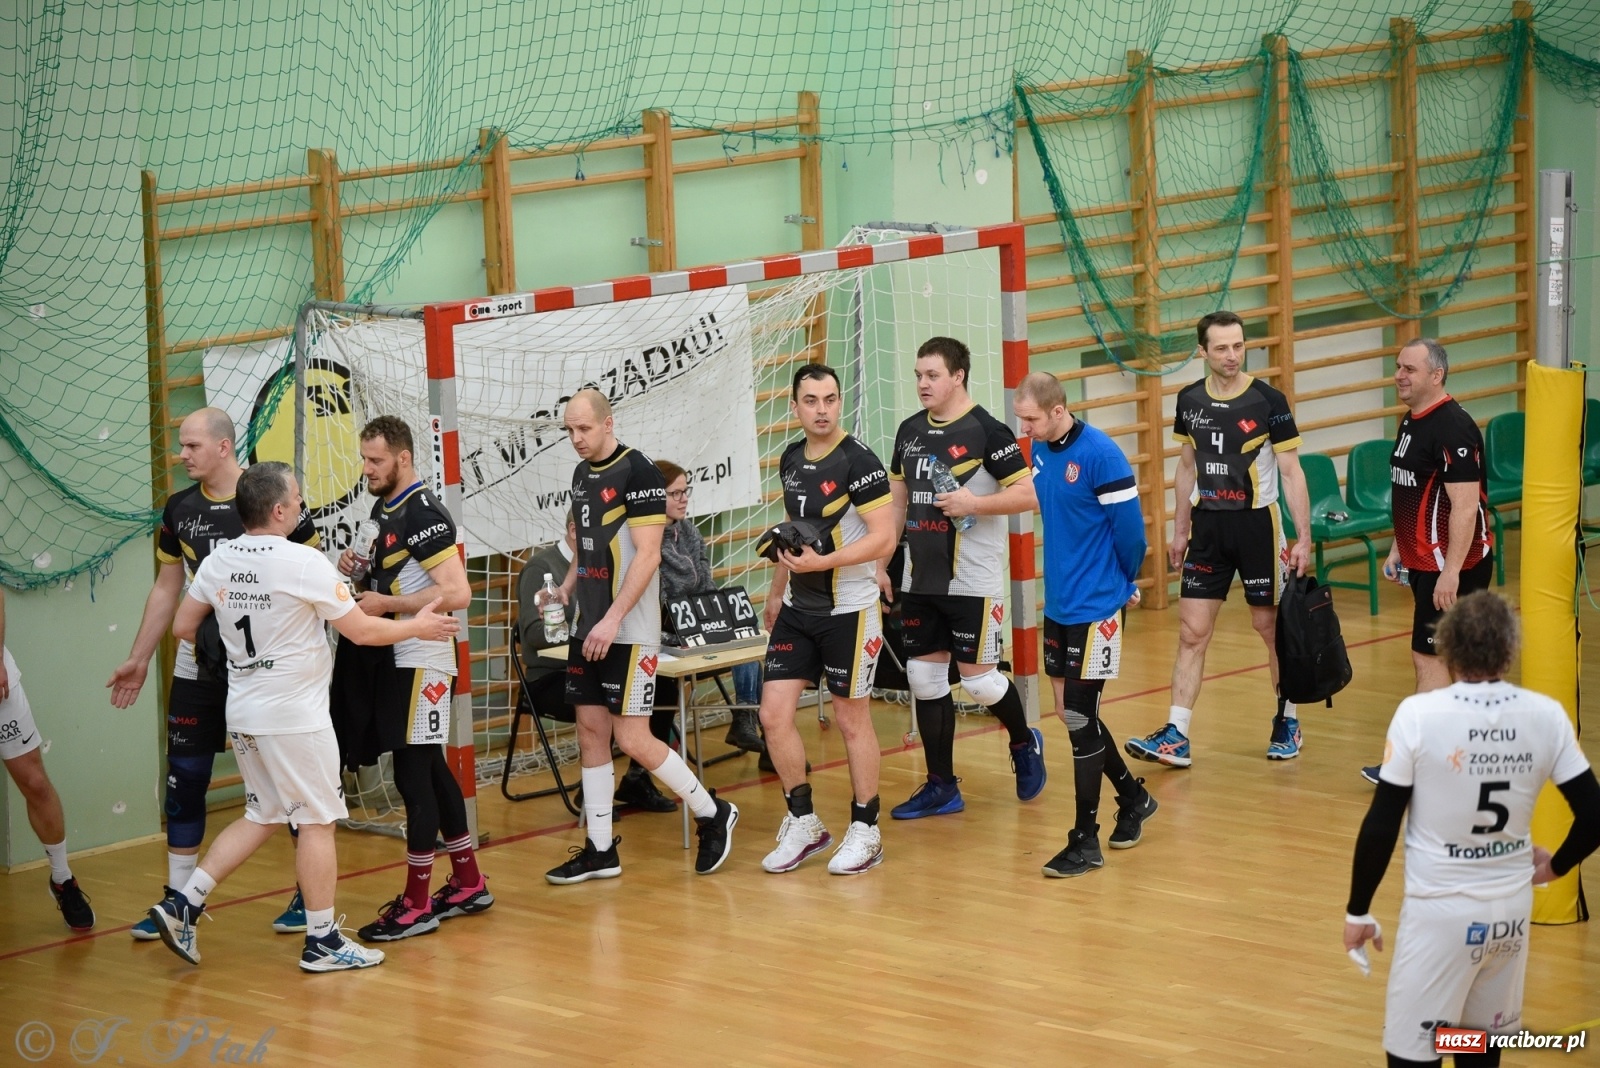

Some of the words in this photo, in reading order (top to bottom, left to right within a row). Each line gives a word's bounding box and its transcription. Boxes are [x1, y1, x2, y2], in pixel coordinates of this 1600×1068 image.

[497, 300, 522, 314] sport
[1211, 432, 1224, 455] 4
[1393, 432, 1412, 459] 10
[915, 457, 932, 480] 14
[1205, 462, 1229, 476] ENTER
[797, 495, 807, 518] 7
[912, 491, 933, 505] ENTER
[581, 504, 590, 528] 2
[230, 570, 259, 584] KRÓL
[228, 601, 272, 611] LUNATYCY
[670, 600, 698, 631] 23
[727, 591, 754, 622] 25
[234, 614, 257, 659] 1
[700, 620, 728, 632] JOOLA
[1102, 646, 1112, 669] 3
[866, 662, 875, 683] 7
[643, 682, 654, 705] 2
[0, 719, 18, 734] OO
[429, 710, 440, 733] 8
[1468, 728, 1517, 742] PYCIU
[1471, 781, 1511, 835] 5
[1492, 917, 1525, 941] DK
[1470, 938, 1522, 966] glass
